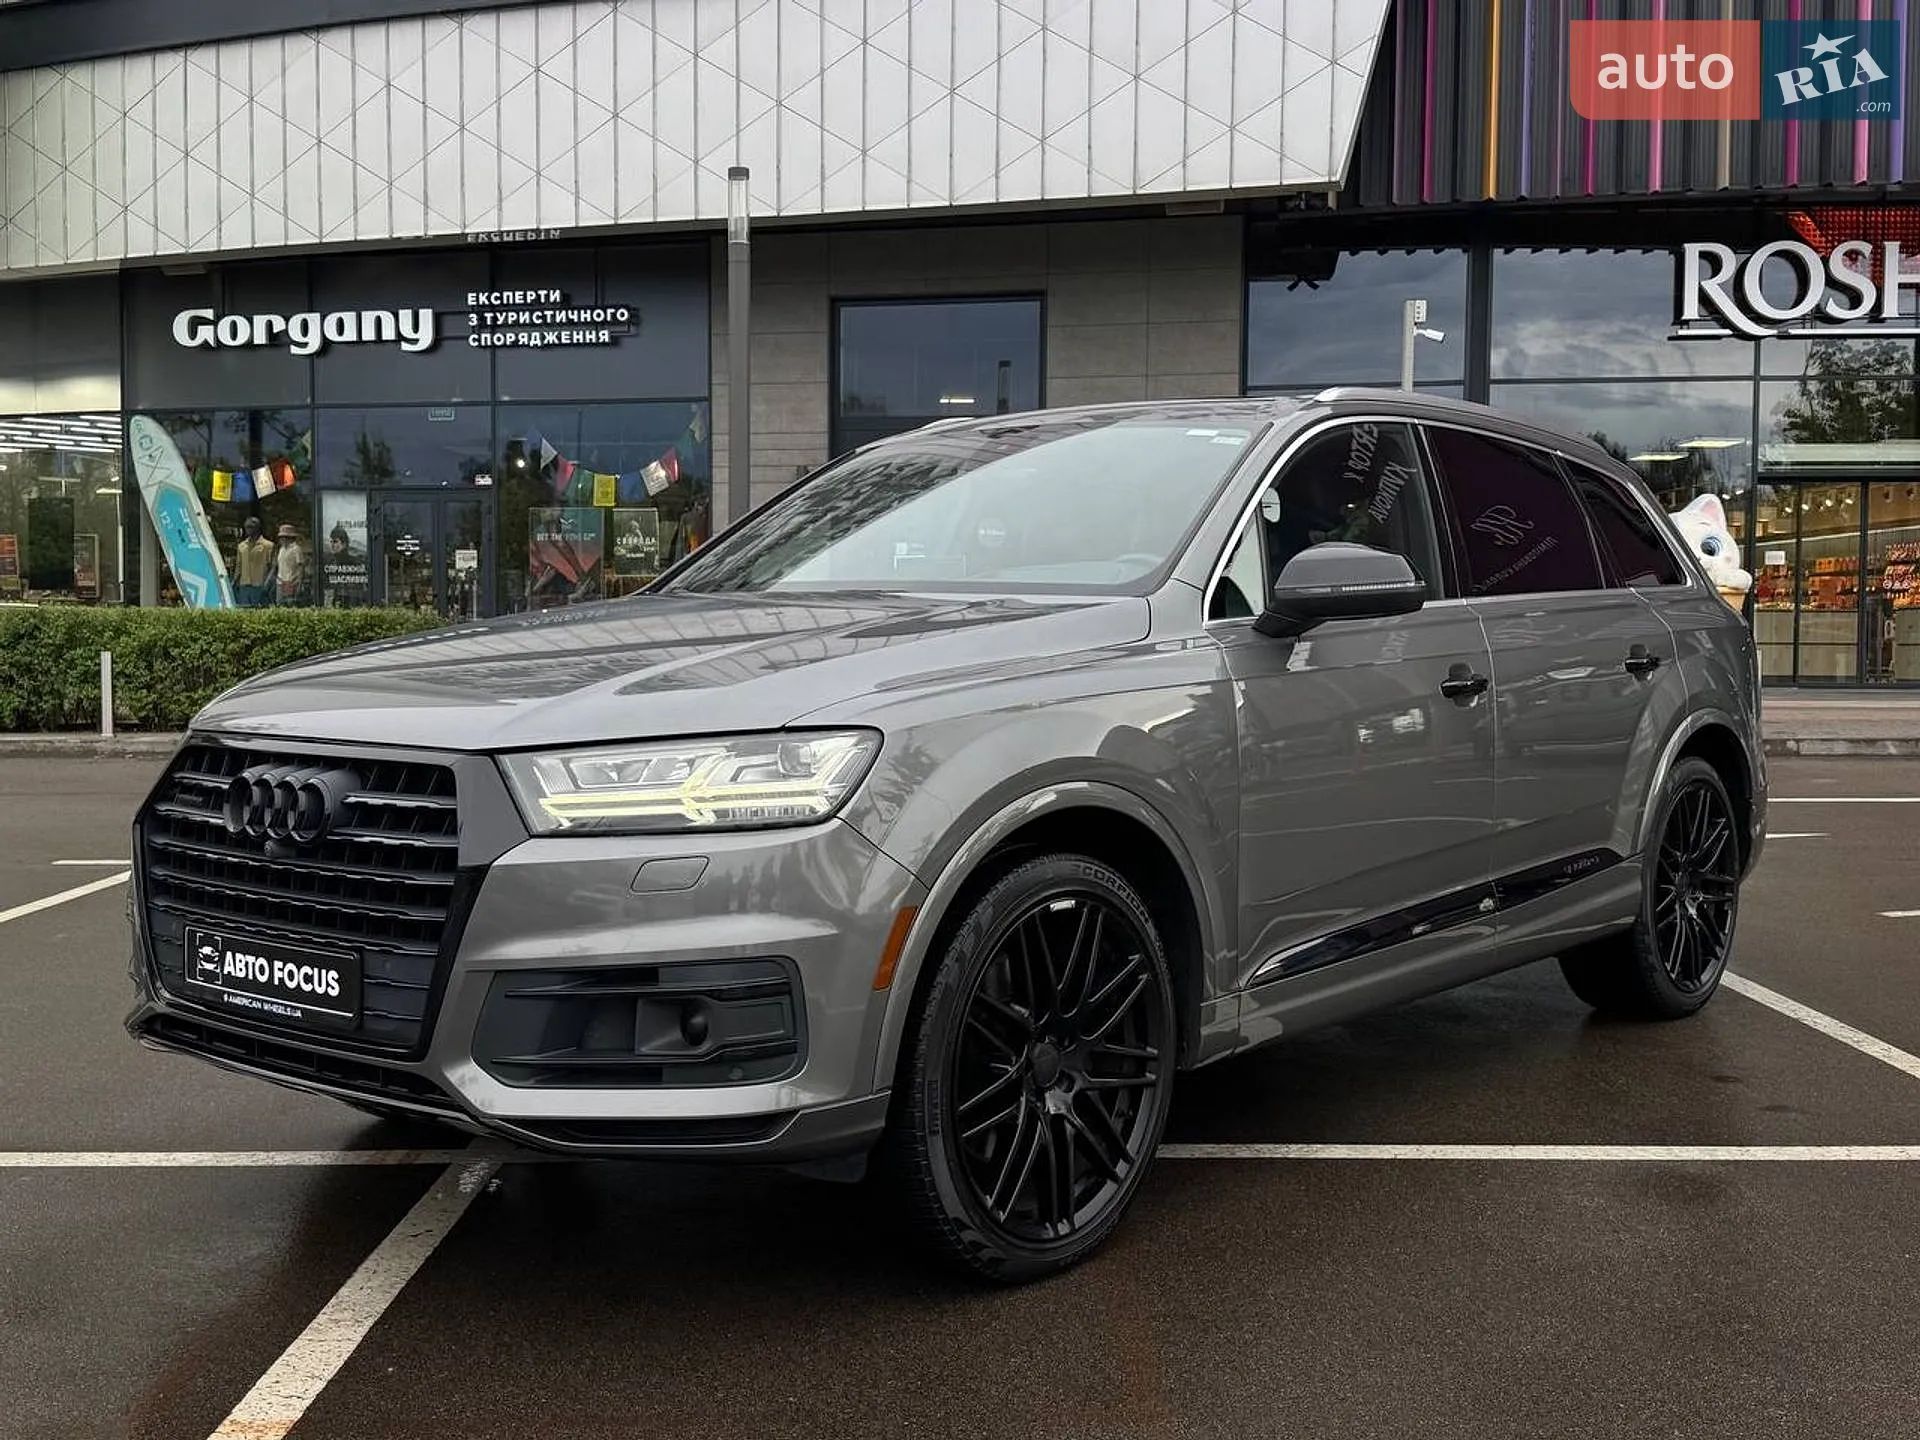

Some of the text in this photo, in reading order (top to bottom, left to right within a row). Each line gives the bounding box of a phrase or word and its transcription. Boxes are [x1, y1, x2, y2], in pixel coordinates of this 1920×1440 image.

[467, 289, 561, 306] ЕКСПЕРТИ
[468, 308, 629, 326] З ТУРИСТИЧНОГО
[172, 308, 435, 356] Gorgany
[468, 329, 610, 347] СПОРЯДЖЕННЯ
[223, 951, 340, 996] АВТО FOCUS
